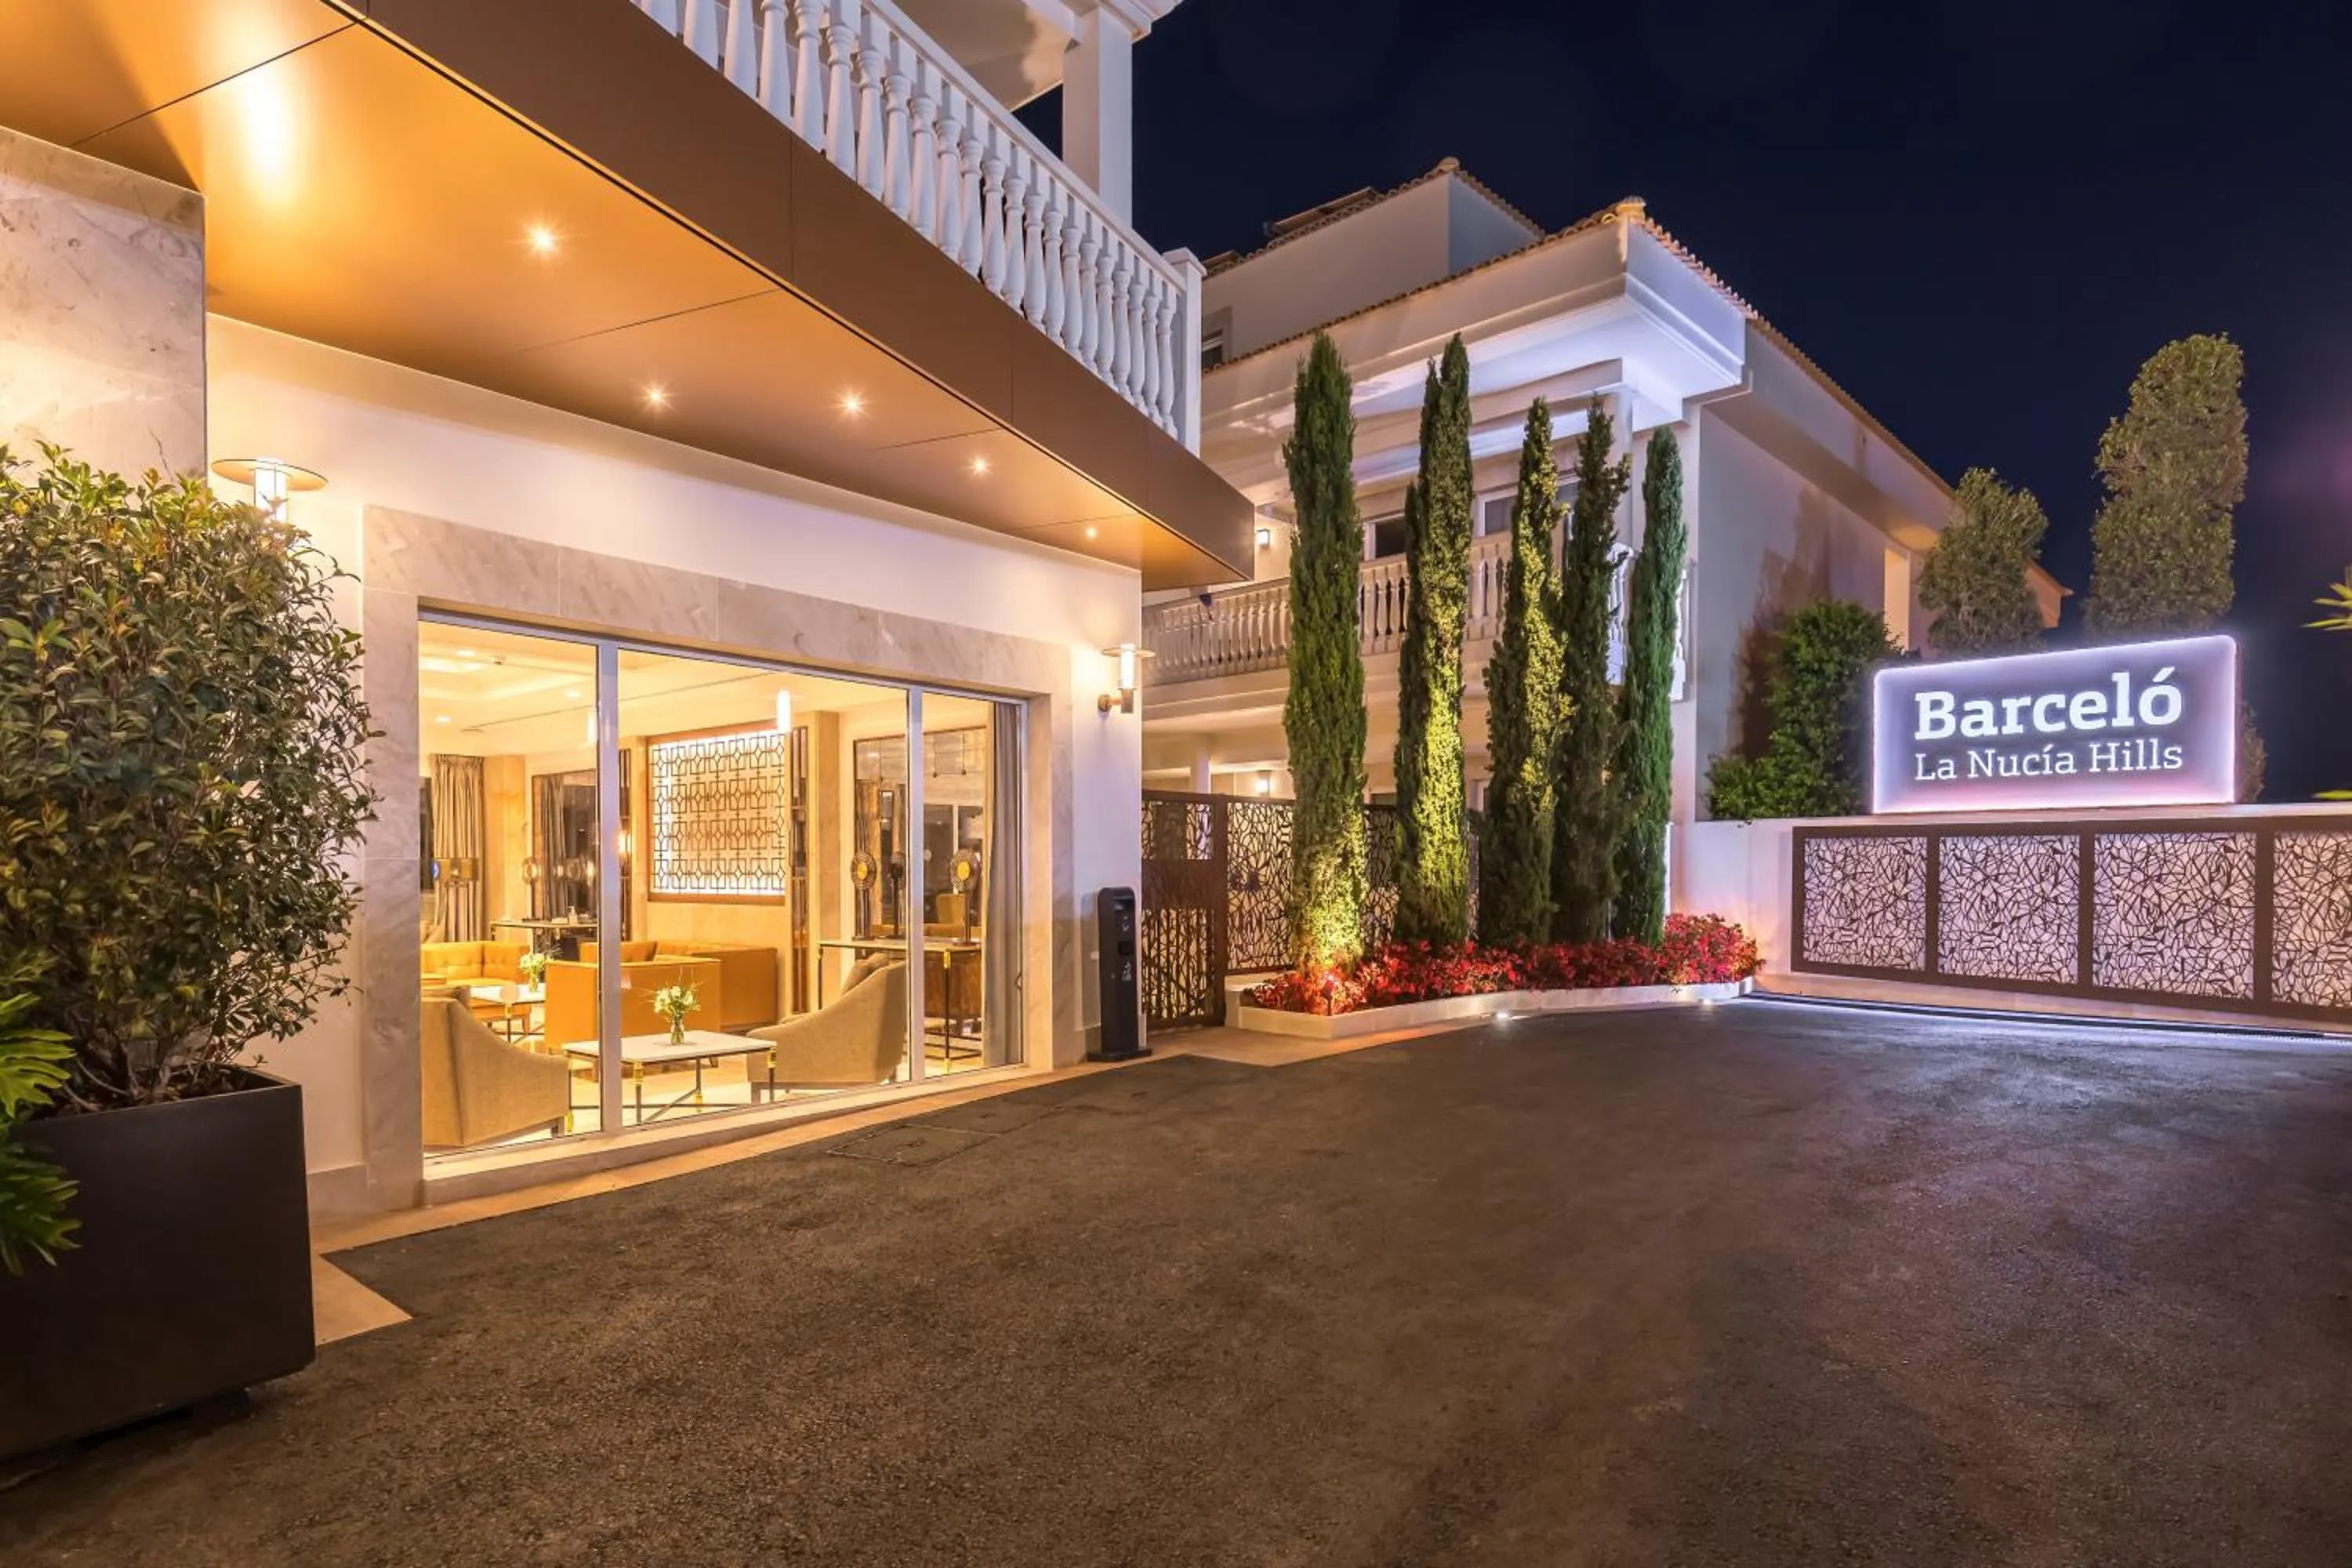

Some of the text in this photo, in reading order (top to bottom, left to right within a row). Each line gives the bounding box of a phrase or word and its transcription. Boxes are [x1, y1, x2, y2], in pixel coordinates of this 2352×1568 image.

[1914, 666, 2183, 740] Barceló
[1915, 739, 2183, 781] La Nucía Hills
